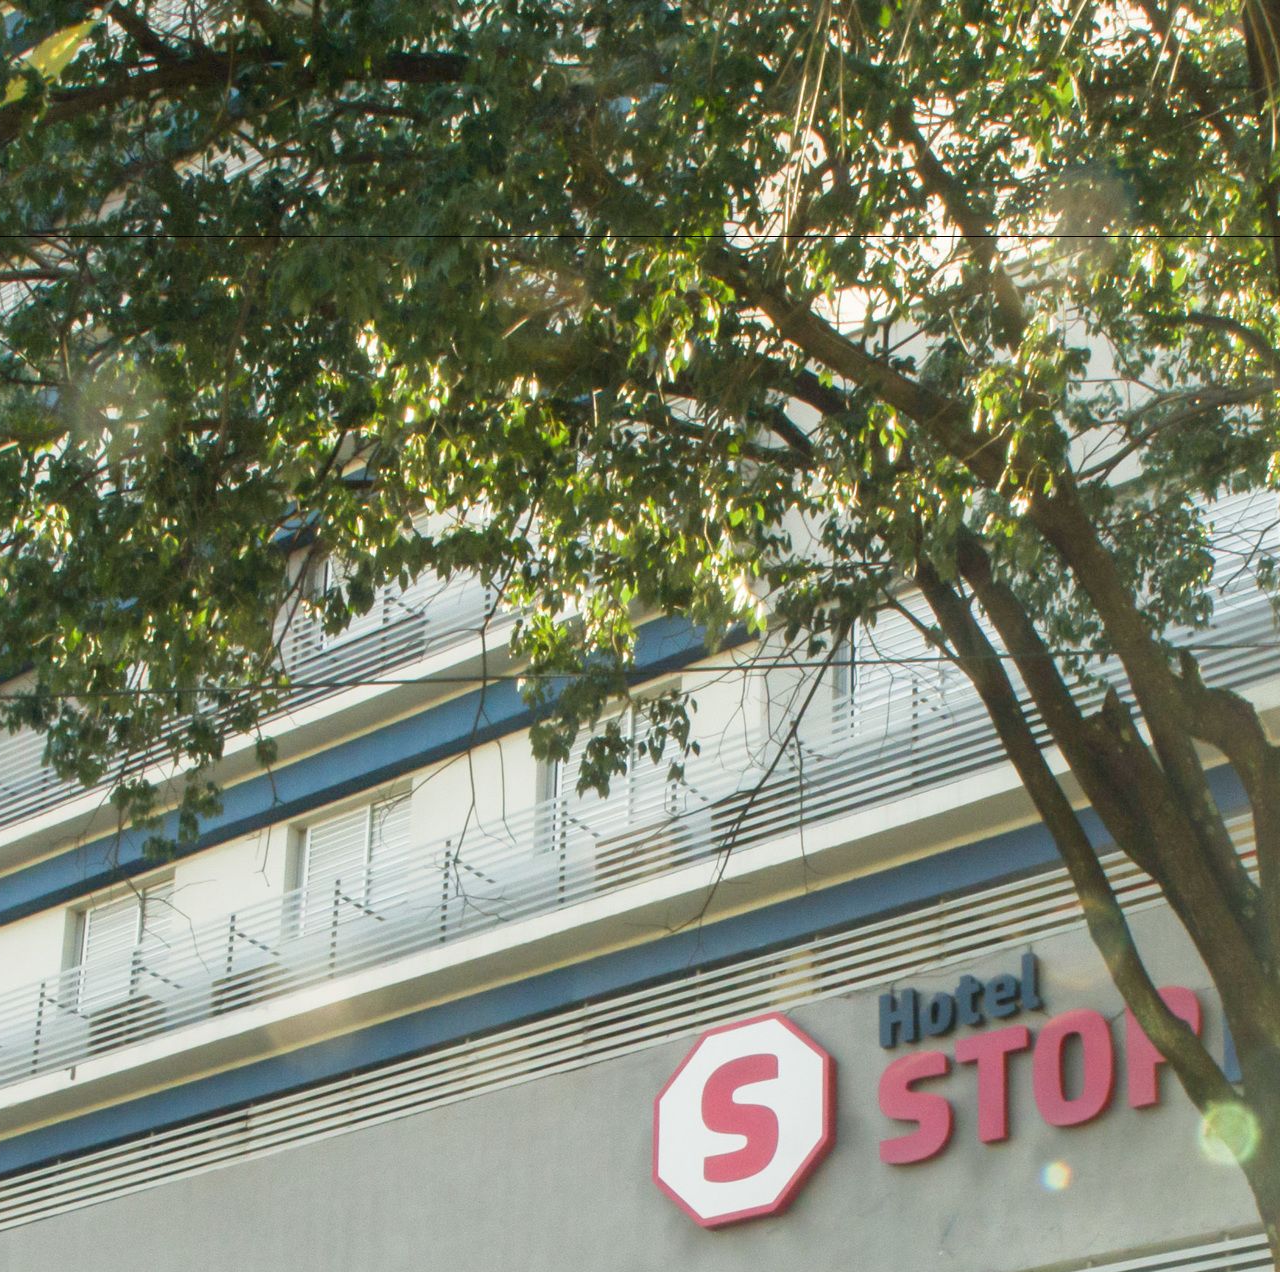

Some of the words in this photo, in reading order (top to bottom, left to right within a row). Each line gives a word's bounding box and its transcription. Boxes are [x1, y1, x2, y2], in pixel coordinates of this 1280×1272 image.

[878, 951, 1043, 1048] Hotel
[701, 1053, 779, 1183] S
[878, 985, 1203, 1165] STOP
